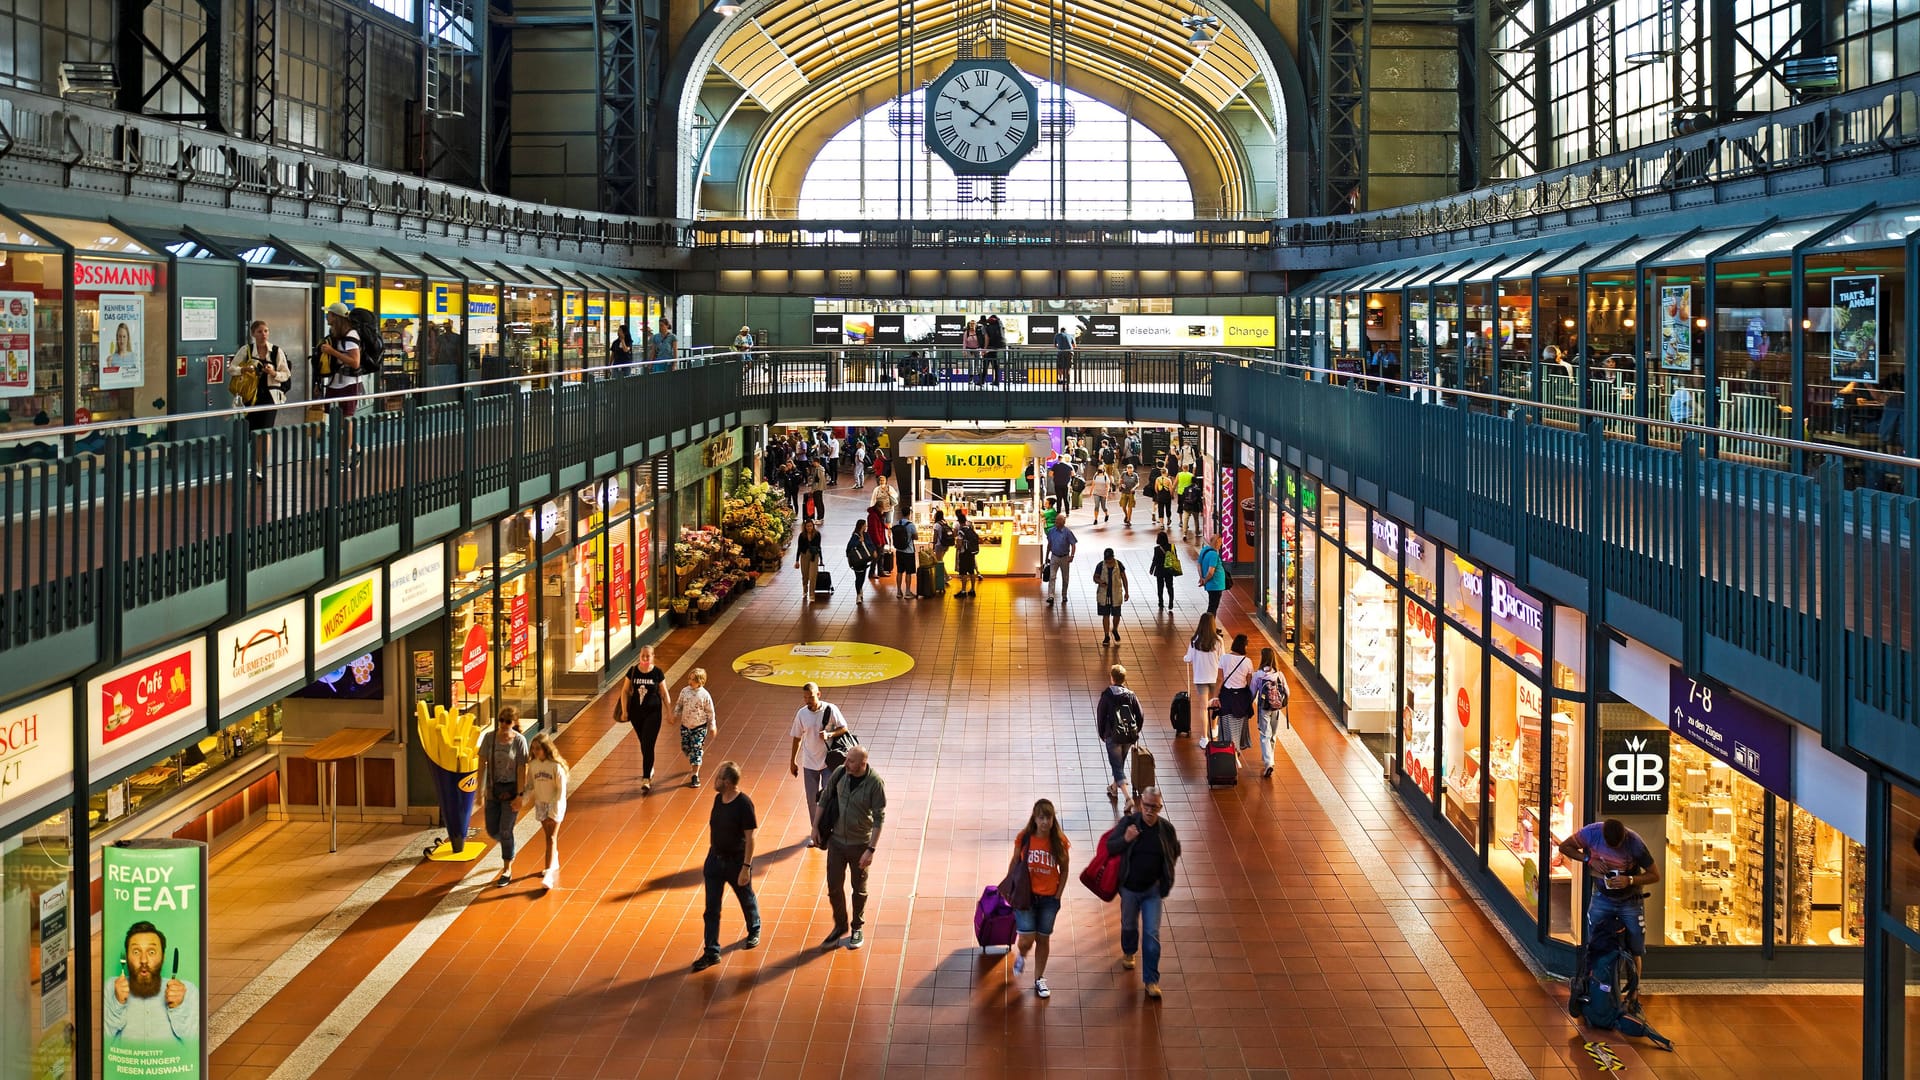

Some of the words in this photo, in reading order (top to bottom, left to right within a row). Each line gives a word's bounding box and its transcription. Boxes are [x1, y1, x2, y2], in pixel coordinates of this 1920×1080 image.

[955, 75, 970, 92] XI
[974, 71, 989, 86] XII
[996, 76, 1006, 90] I
[941, 92, 957, 104] X
[1007, 91, 1022, 103] II
[1011, 111, 1027, 120] III
[1840, 290, 1865, 302] THAT'S
[1849, 297, 1875, 309] AMORE
[1126, 324, 1171, 335] reisebank
[1229, 326, 1270, 338] Change
[945, 455, 967, 466] Mr.
[968, 454, 1006, 467] CLOU
[324, 605, 347, 638] WURST
[350, 582, 371, 612] DURST
[233, 647, 289, 678] GOURMET-STATION
[136, 669, 163, 704] Café
[1520, 685, 1542, 715] SALE
[1688, 677, 1712, 713] 7-8
[1458, 697, 1469, 710] SALE
[1687, 716, 1694, 726] zu
[1694, 719, 1705, 732] den
[1705, 724, 1723, 742] Zügen
[1608, 794, 1628, 802] BIJOU
[108, 864, 174, 884] READY
[114, 888, 130, 901] TO
[133, 884, 196, 912] EAT
[108, 1054, 139, 1065] GROSSER
[140, 1056, 181, 1065] HUNGER?
[117, 1065, 144, 1075] RIESEN
[145, 1064, 194, 1075] AUSWAHL!
